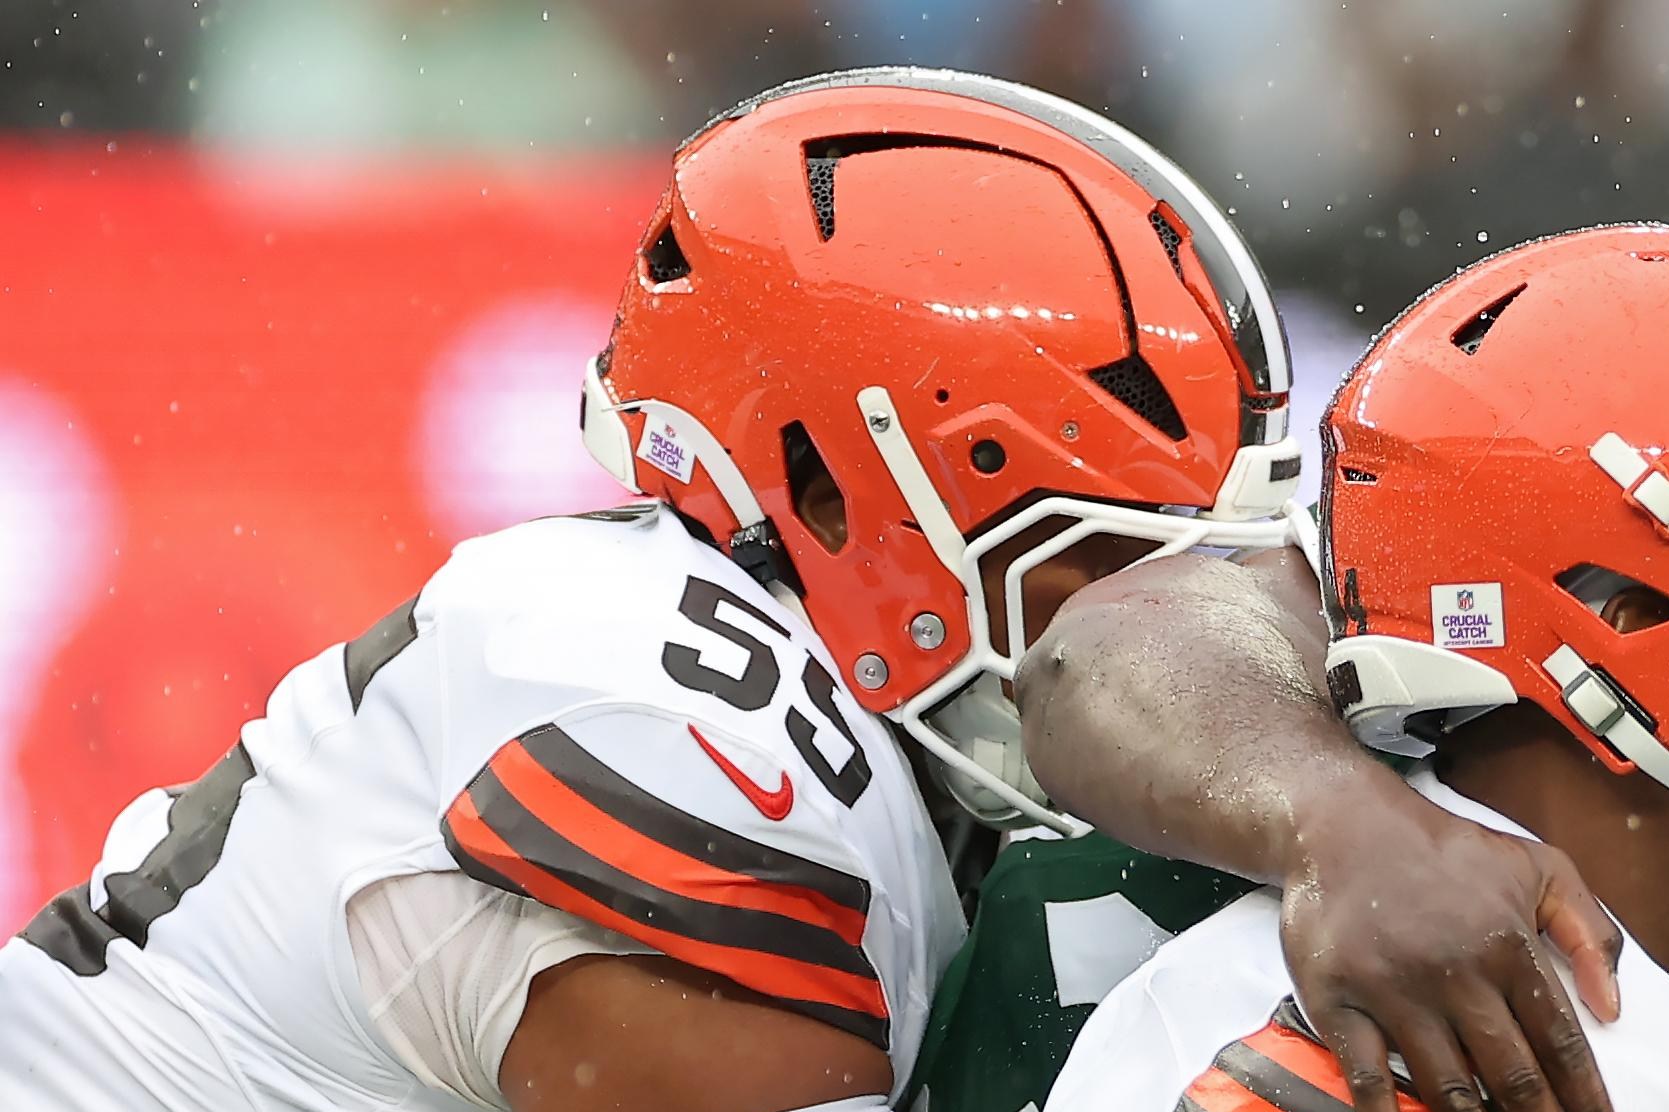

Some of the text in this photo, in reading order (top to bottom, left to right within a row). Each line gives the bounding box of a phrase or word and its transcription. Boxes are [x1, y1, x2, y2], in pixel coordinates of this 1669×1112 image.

[650, 431, 685, 461] CRUCIAL
[652, 445, 680, 470] CATCH
[1442, 614, 1493, 627] CRUCIAL
[1448, 627, 1487, 639] CATCH
